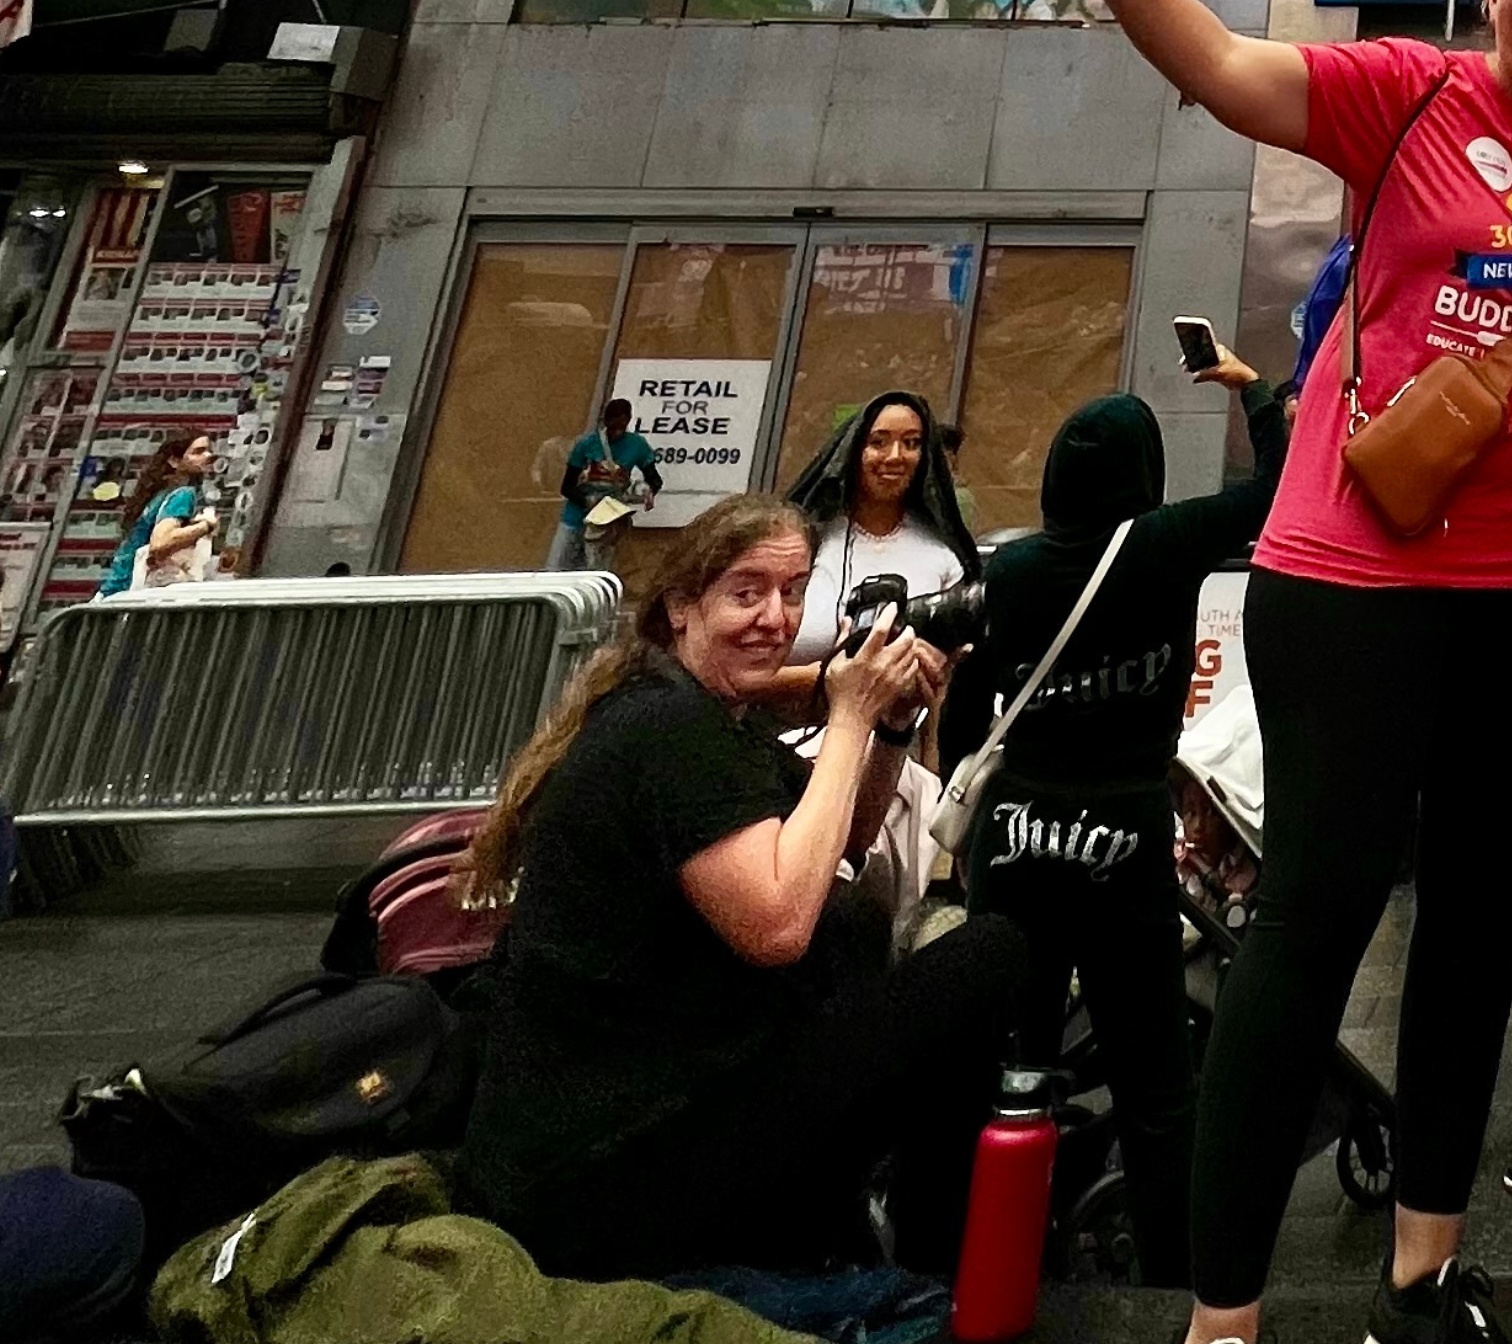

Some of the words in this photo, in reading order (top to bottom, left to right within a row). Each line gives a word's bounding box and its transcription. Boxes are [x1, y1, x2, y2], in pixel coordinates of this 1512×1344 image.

[1426, 332, 1476, 358] EDUCATE
[639, 380, 738, 398] RETAIL
[662, 400, 709, 415] FOR
[635, 417, 731, 435] LEASE
[990, 800, 1139, 882] Juicy
